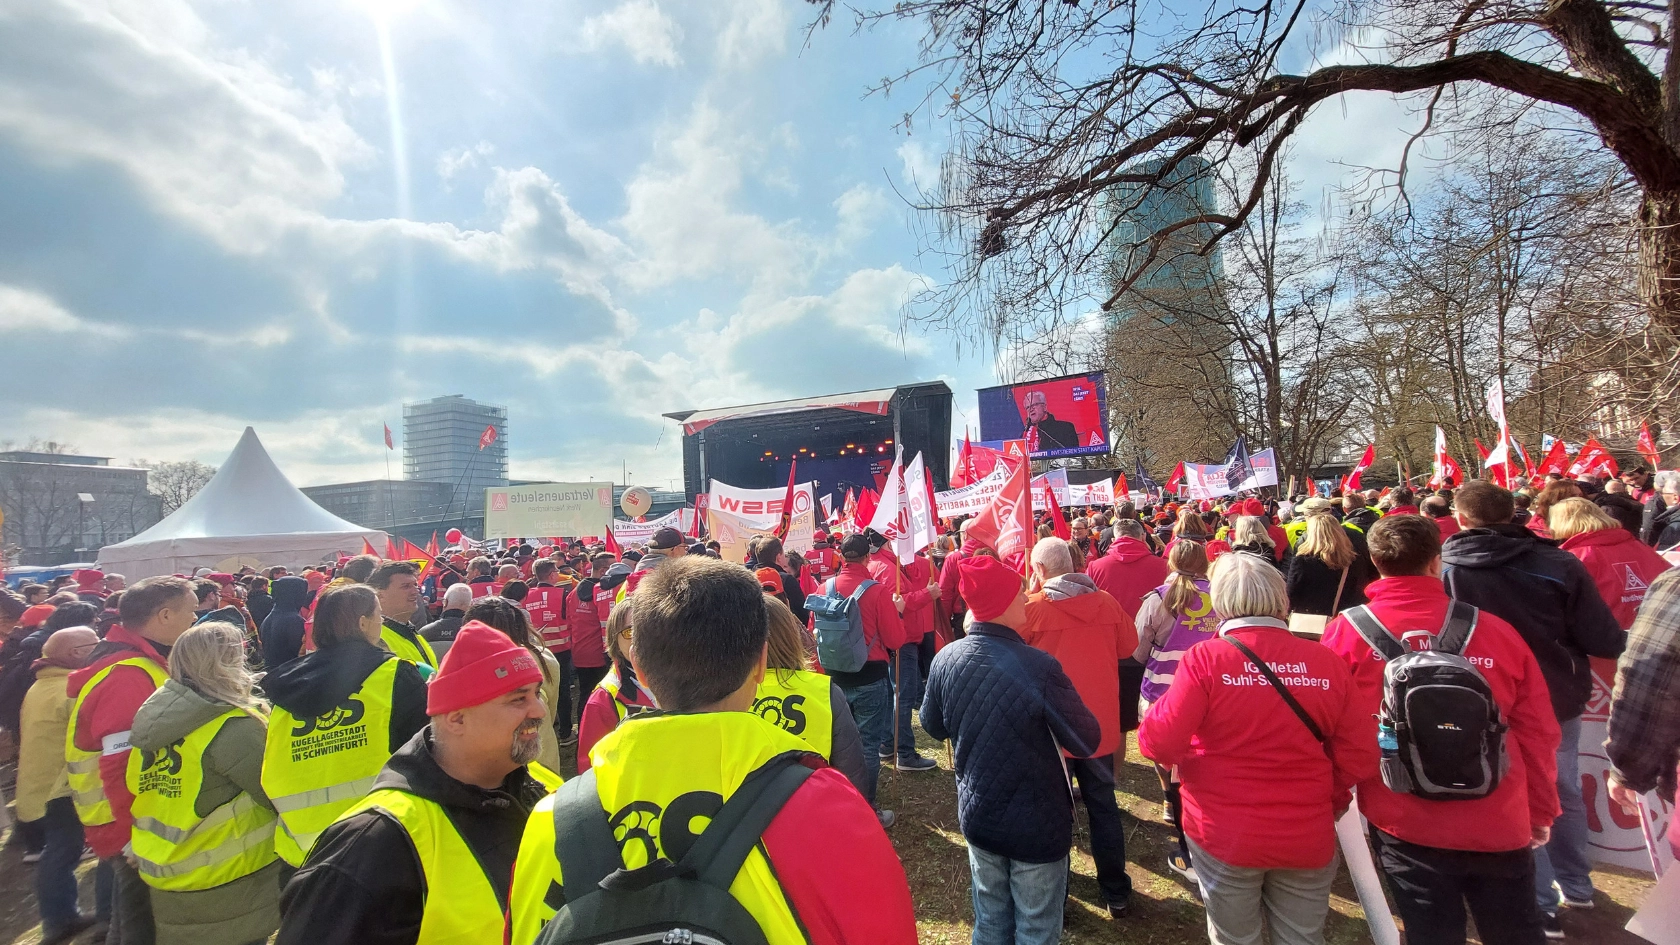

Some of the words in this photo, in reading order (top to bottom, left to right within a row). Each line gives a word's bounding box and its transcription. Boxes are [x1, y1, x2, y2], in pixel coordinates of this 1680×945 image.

[1243, 662, 1259, 673] IG
[1268, 662, 1307, 674] Metall
[291, 724, 367, 749] KUGELLAGERSTADT
[292, 753, 301, 762] IN
[303, 738, 368, 760] SCHWEINFURT!
